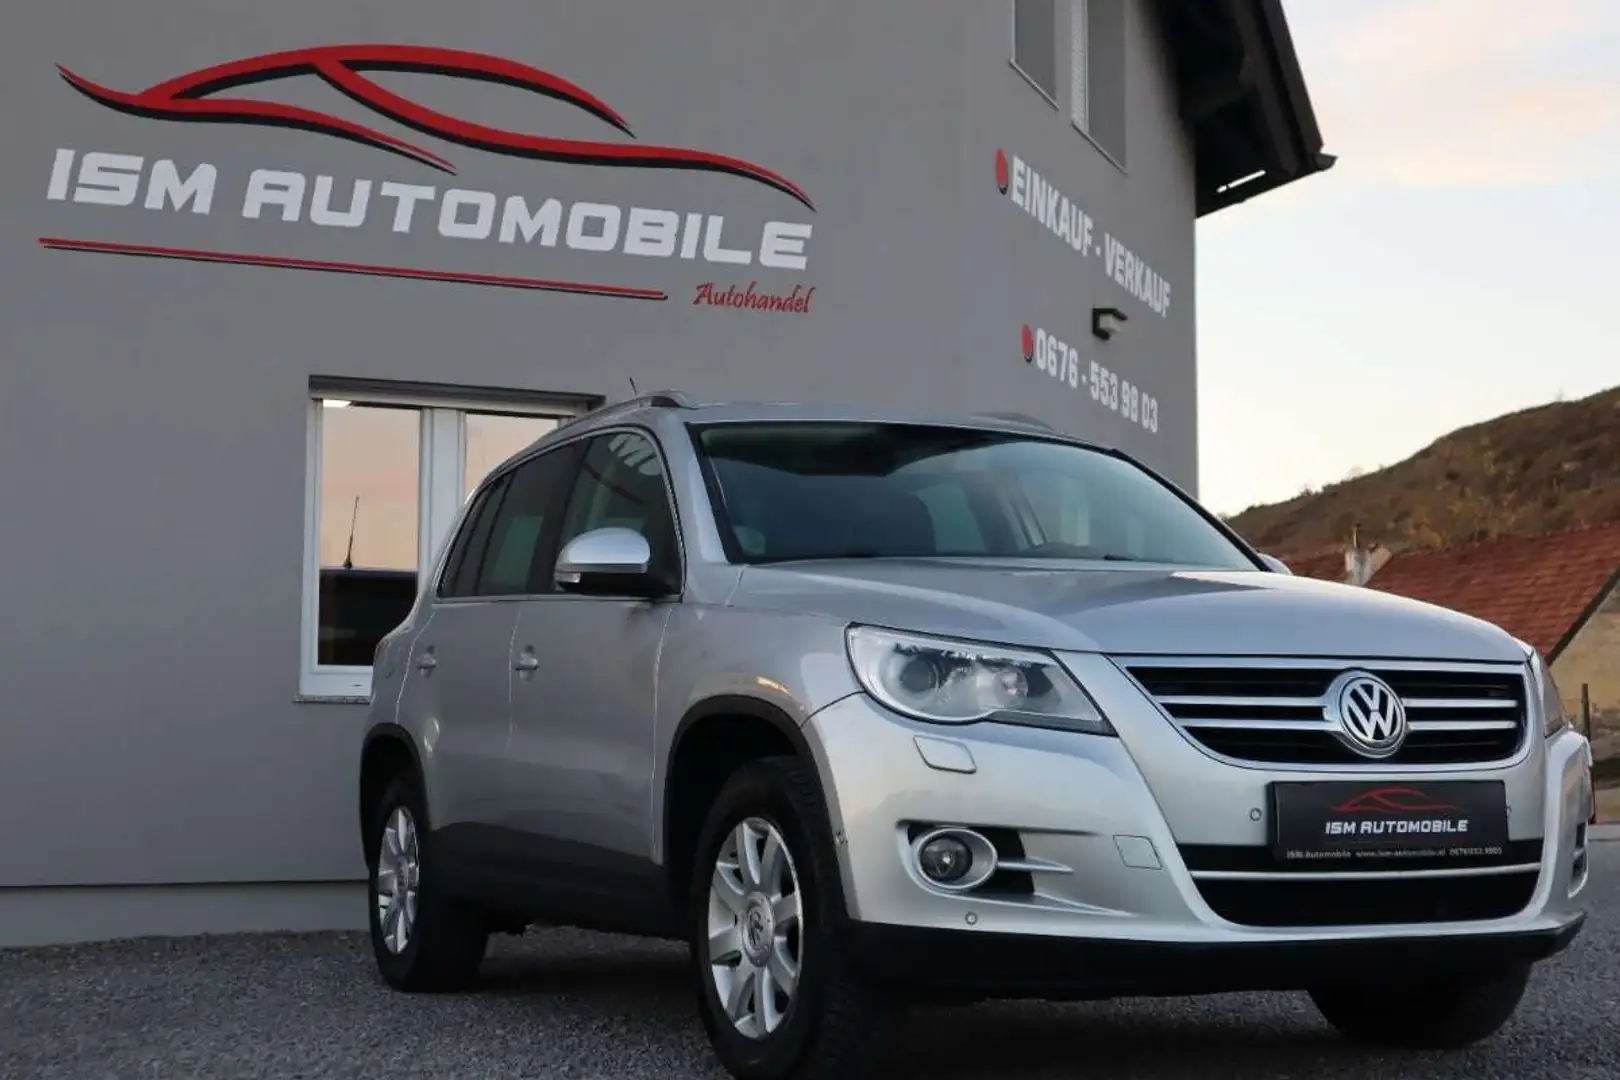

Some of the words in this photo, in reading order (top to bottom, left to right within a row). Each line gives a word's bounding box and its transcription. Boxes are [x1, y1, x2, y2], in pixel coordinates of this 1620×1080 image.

[47, 148, 217, 215] ISM
[242, 169, 813, 271] AUTOMOBILE
[1011, 155, 1093, 257] EINKAUF
[1104, 232, 1171, 318] VERKAUF
[692, 280, 816, 313] Autohandel
[1035, 327, 1079, 389] 0676
[1089, 360, 1119, 411] 553
[1141, 393, 1158, 433] 03
[1325, 821, 1356, 835] ISM
[1360, 819, 1469, 834] AUTOMOBILE
